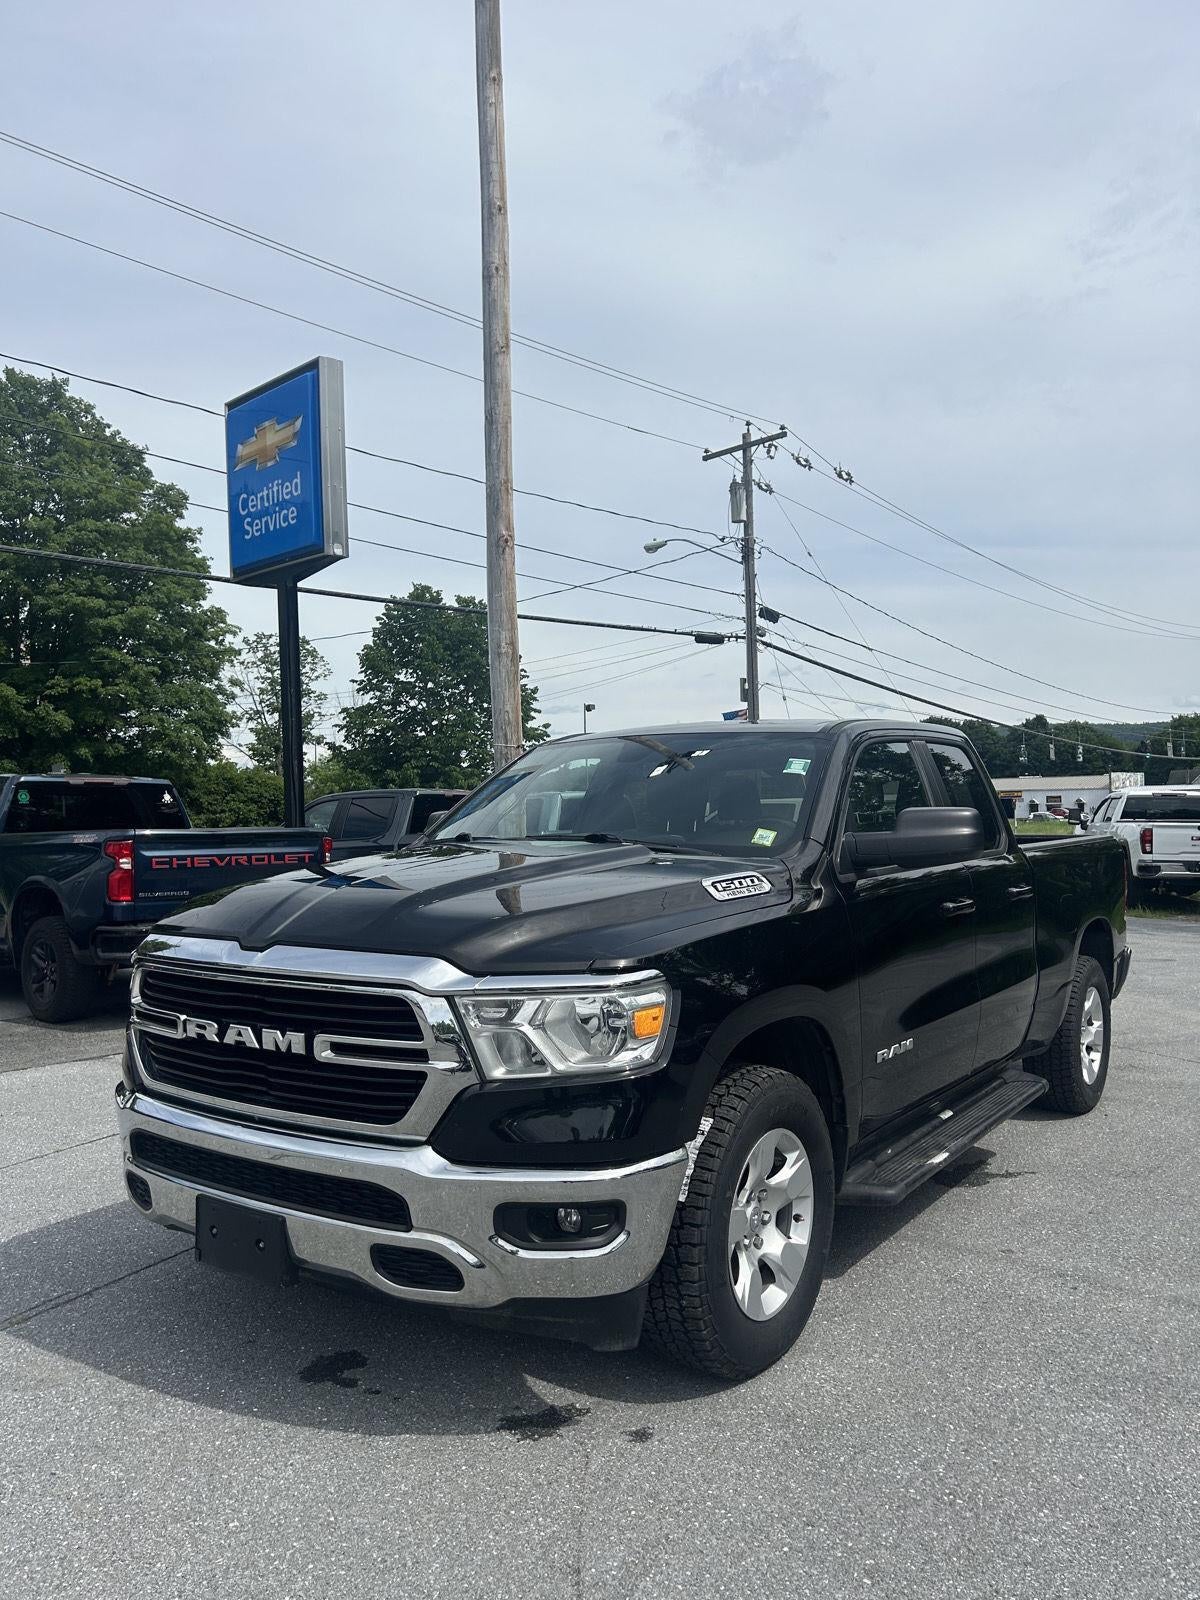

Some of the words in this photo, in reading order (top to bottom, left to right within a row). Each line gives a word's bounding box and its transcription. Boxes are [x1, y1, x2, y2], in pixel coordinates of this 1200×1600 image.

[238, 471, 301, 516] Certified
[244, 505, 297, 540] Service
[152, 853, 314, 869] CHEVROLET
[138, 890, 190, 898] SILVERADO
[713, 877, 760, 892] 1500
[184, 1017, 306, 1055] RAM
[876, 1037, 914, 1064] RAM
